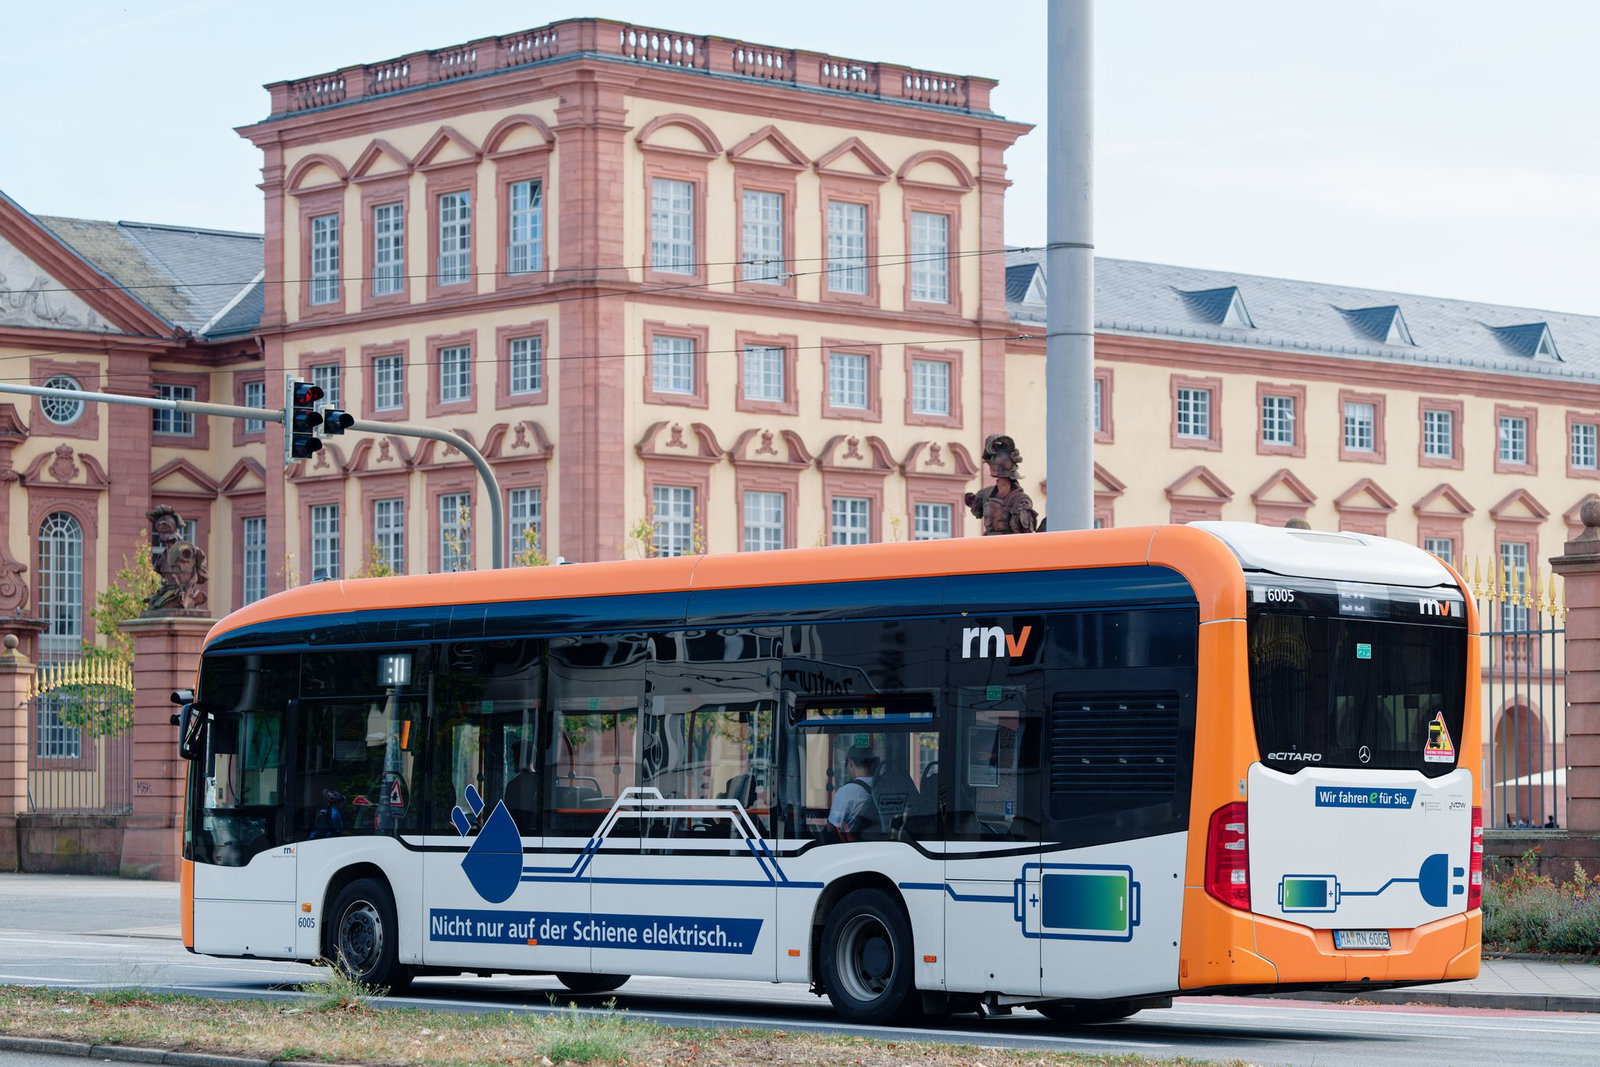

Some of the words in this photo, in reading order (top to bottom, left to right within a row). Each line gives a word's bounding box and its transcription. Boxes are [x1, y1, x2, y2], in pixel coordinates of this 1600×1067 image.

[1267, 588, 1295, 603] 6005
[1419, 598, 1449, 616] rnv
[962, 626, 1032, 658] rnv
[1320, 791, 1337, 803] Wir
[1339, 791, 1368, 804] fahren
[1369, 792, 1378, 804] e
[1379, 792, 1393, 805] für
[1394, 793, 1410, 805] Sie.
[298, 917, 315, 928] 6005
[432, 915, 472, 937] Nicht
[476, 921, 504, 938] nur
[508, 918, 535, 939] auf
[539, 918, 567, 940] der
[573, 920, 637, 944] Schiene
[642, 922, 743, 948] elektrisch...
[1369, 932, 1388, 945] 6005
